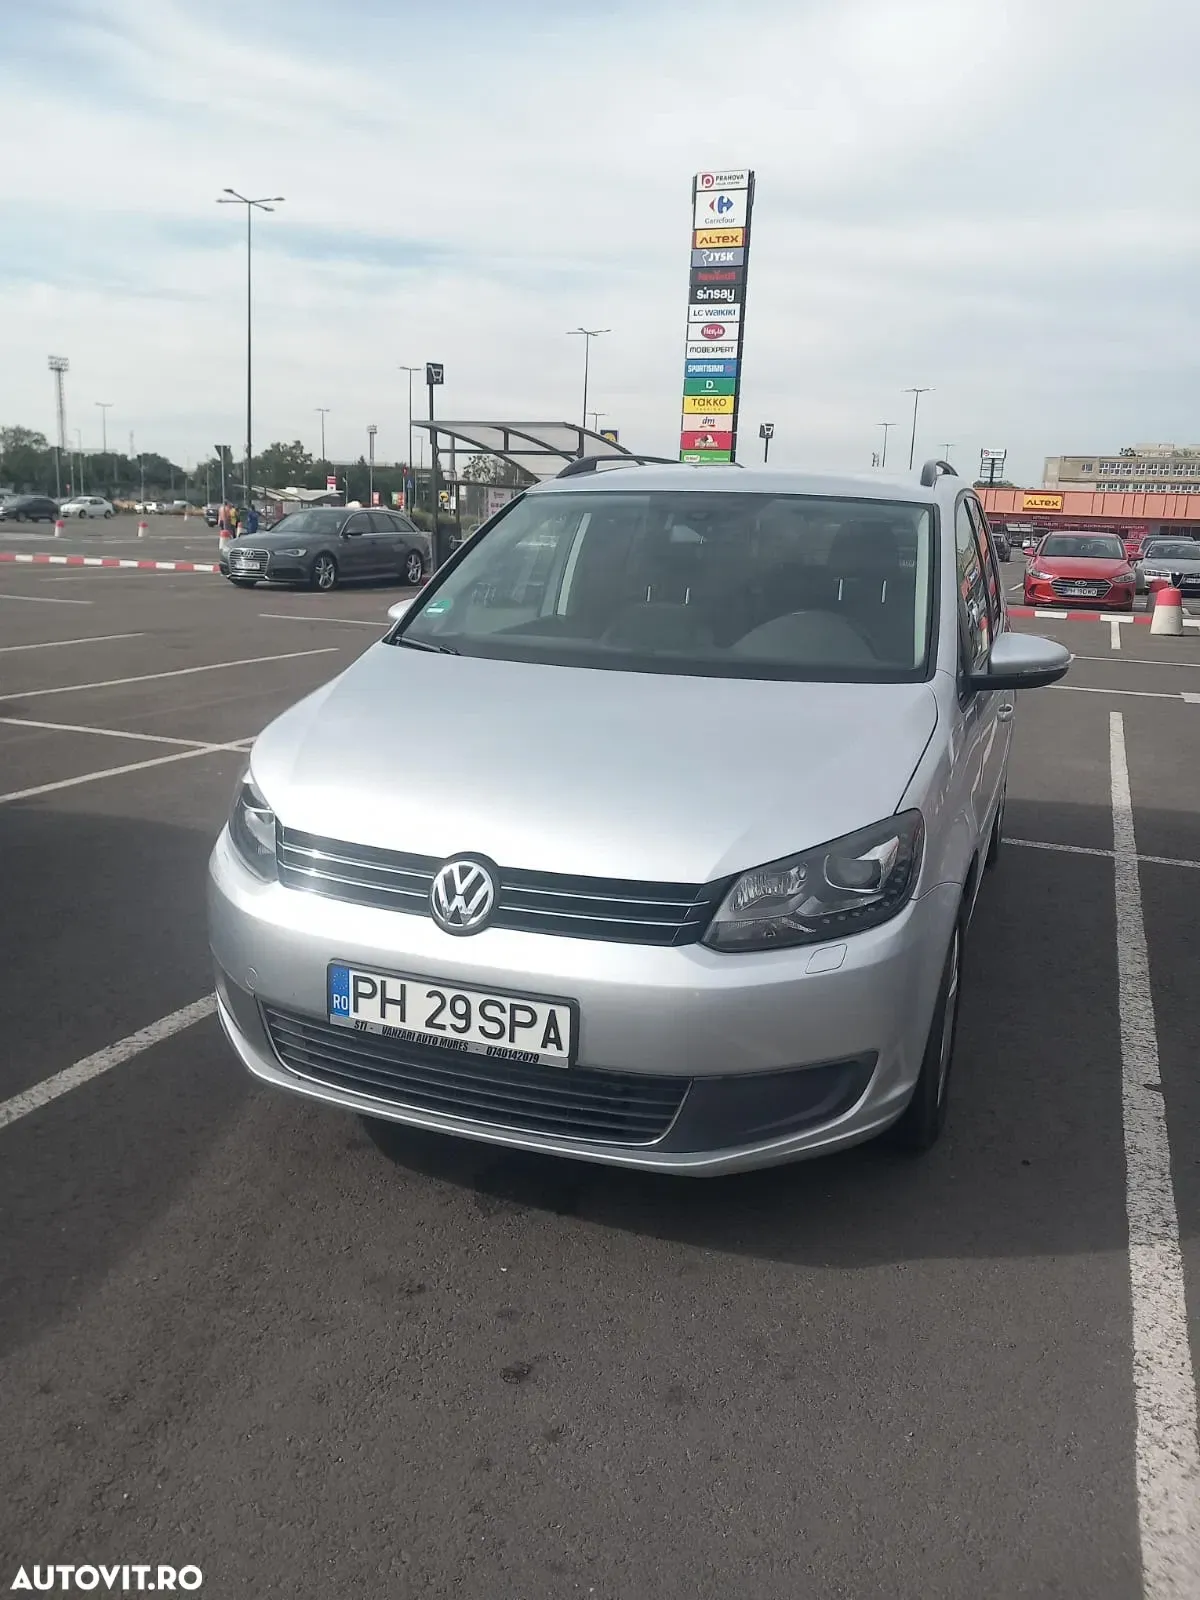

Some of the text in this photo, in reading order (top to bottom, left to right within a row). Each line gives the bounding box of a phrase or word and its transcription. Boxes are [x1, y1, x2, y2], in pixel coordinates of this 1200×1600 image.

[708, 252, 734, 262] JYSK
[697, 286, 735, 302] sinsay
[702, 416, 715, 425] dm
[333, 993, 348, 1010] RO
[352, 974, 406, 1023] PH
[354, 1020, 368, 1031] STI
[381, 1025, 415, 1041] VANZARI
[416, 1032, 438, 1046] AUTO
[439, 1039, 469, 1051] MURES
[486, 1046, 540, 1064] 0740142079
